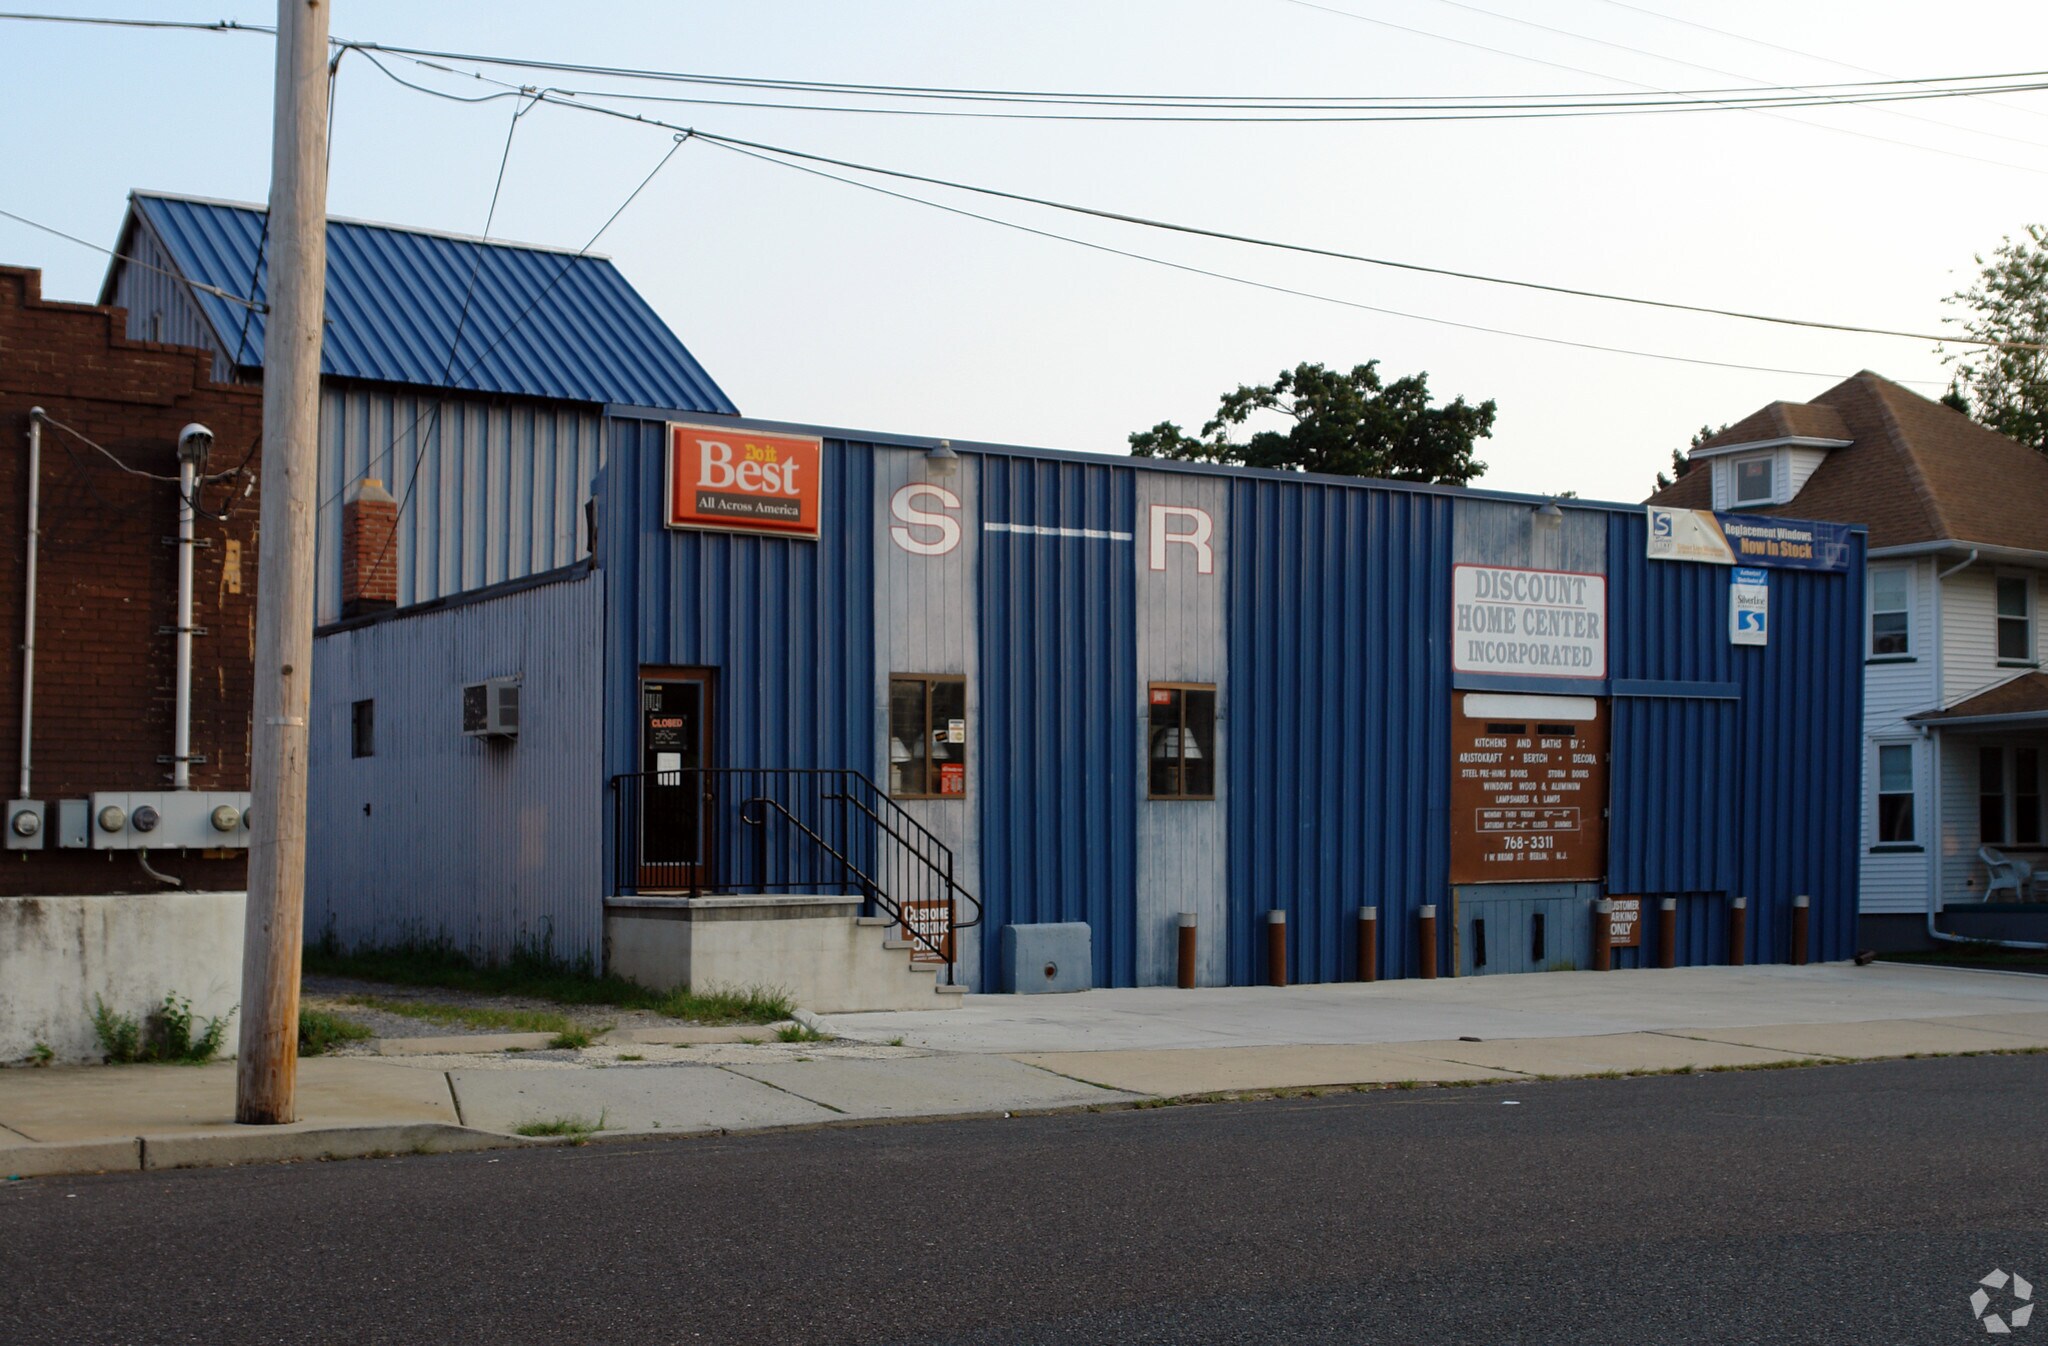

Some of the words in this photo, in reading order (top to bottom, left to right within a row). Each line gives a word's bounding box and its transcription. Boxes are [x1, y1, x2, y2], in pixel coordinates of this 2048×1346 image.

[745, 444, 764, 461] Do
[765, 445, 778, 463] it
[696, 439, 800, 495] Best
[698, 497, 716, 509] All
[718, 499, 752, 512] Across
[755, 502, 799, 516] America
[890, 482, 962, 556] S
[1150, 504, 1214, 575] R
[1725, 522, 1777, 538] Replacement
[1777, 527, 1812, 541] Windows
[1741, 537, 1766, 555] Now
[1780, 541, 1813, 558] Stock
[1475, 570, 1587, 605] DISCOUNT
[1457, 604, 1516, 634] HOME
[1523, 608, 1600, 639] CENTER
[1468, 640, 1593, 667] INCORPORATED
[651, 718, 683, 728] CLOSED
[1475, 738, 1507, 748] KITCHENS
[1516, 739, 1532, 748] AND
[1541, 739, 1562, 749] BATHS
[1459, 753, 1503, 763] ARISTOKRAFT
[1523, 753, 1548, 763] BERTCH
[1572, 754, 1597, 764] DECORA
[1461, 769, 1478, 778] STEEL
[1510, 769, 1529, 778] DOORS
[1483, 782, 1513, 791] WINDOWS
[1519, 782, 1537, 791] WOOD
[1551, 782, 1581, 791] ALUMINUM
[1495, 795, 1530, 804] LAMPSHADES
[1543, 795, 1561, 804] LAMPS
[1503, 836, 1554, 850] 768-3311
[1611, 900, 1640, 910] USTOMER
[904, 906, 949, 921] CUSTOME
[1611, 911, 1638, 922] ARKING
[1610, 922, 1633, 936] ONLY
[913, 934, 945, 951] ONLY
